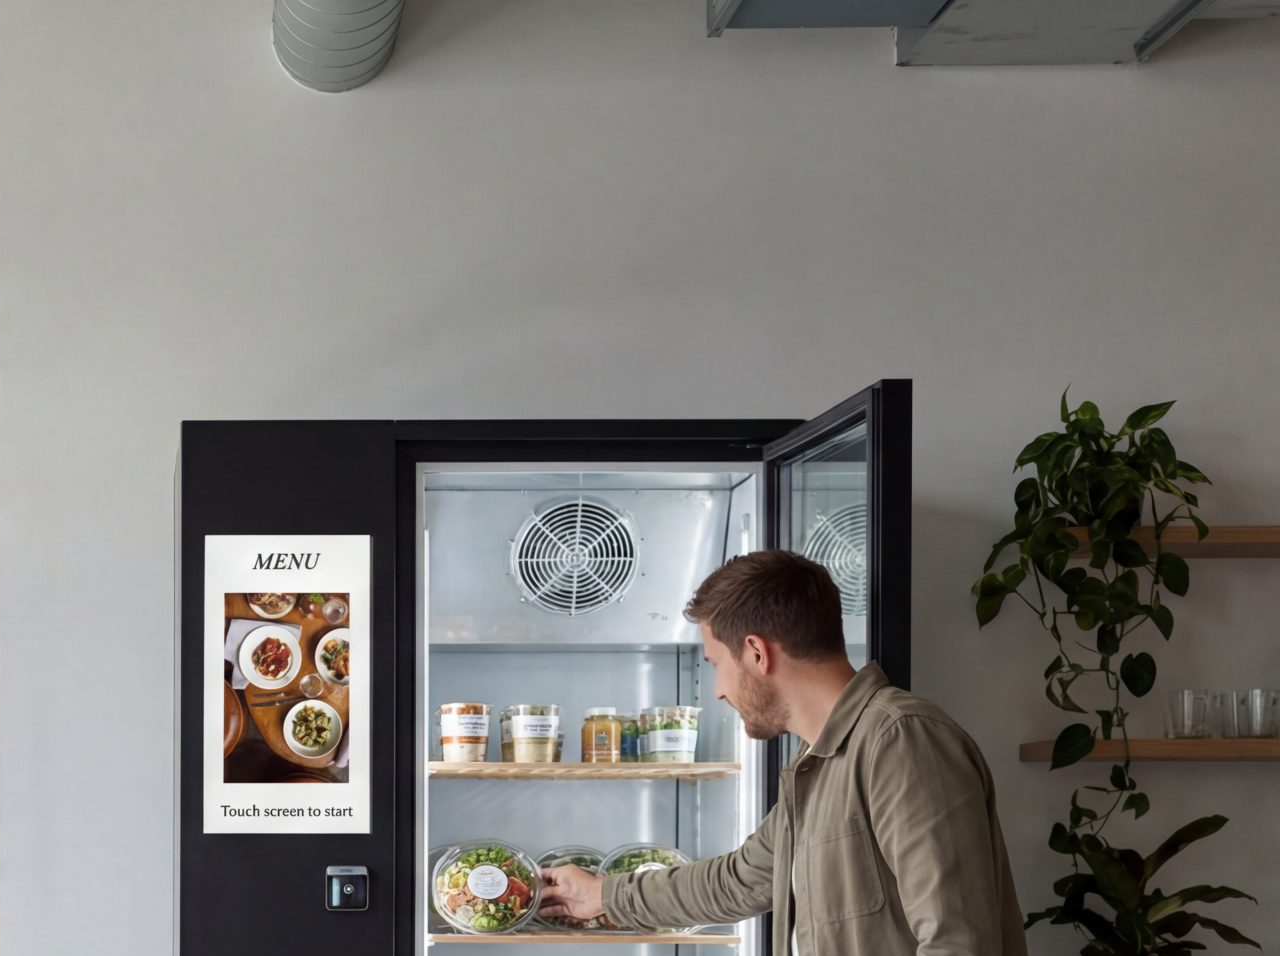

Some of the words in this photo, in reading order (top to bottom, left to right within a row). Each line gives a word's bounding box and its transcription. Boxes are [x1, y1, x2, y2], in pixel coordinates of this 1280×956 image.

[252, 552, 321, 570] MENU
[220, 804, 260, 817] Touch
[263, 807, 305, 817] screen
[307, 806, 321, 817] to
[324, 806, 353, 817] start
